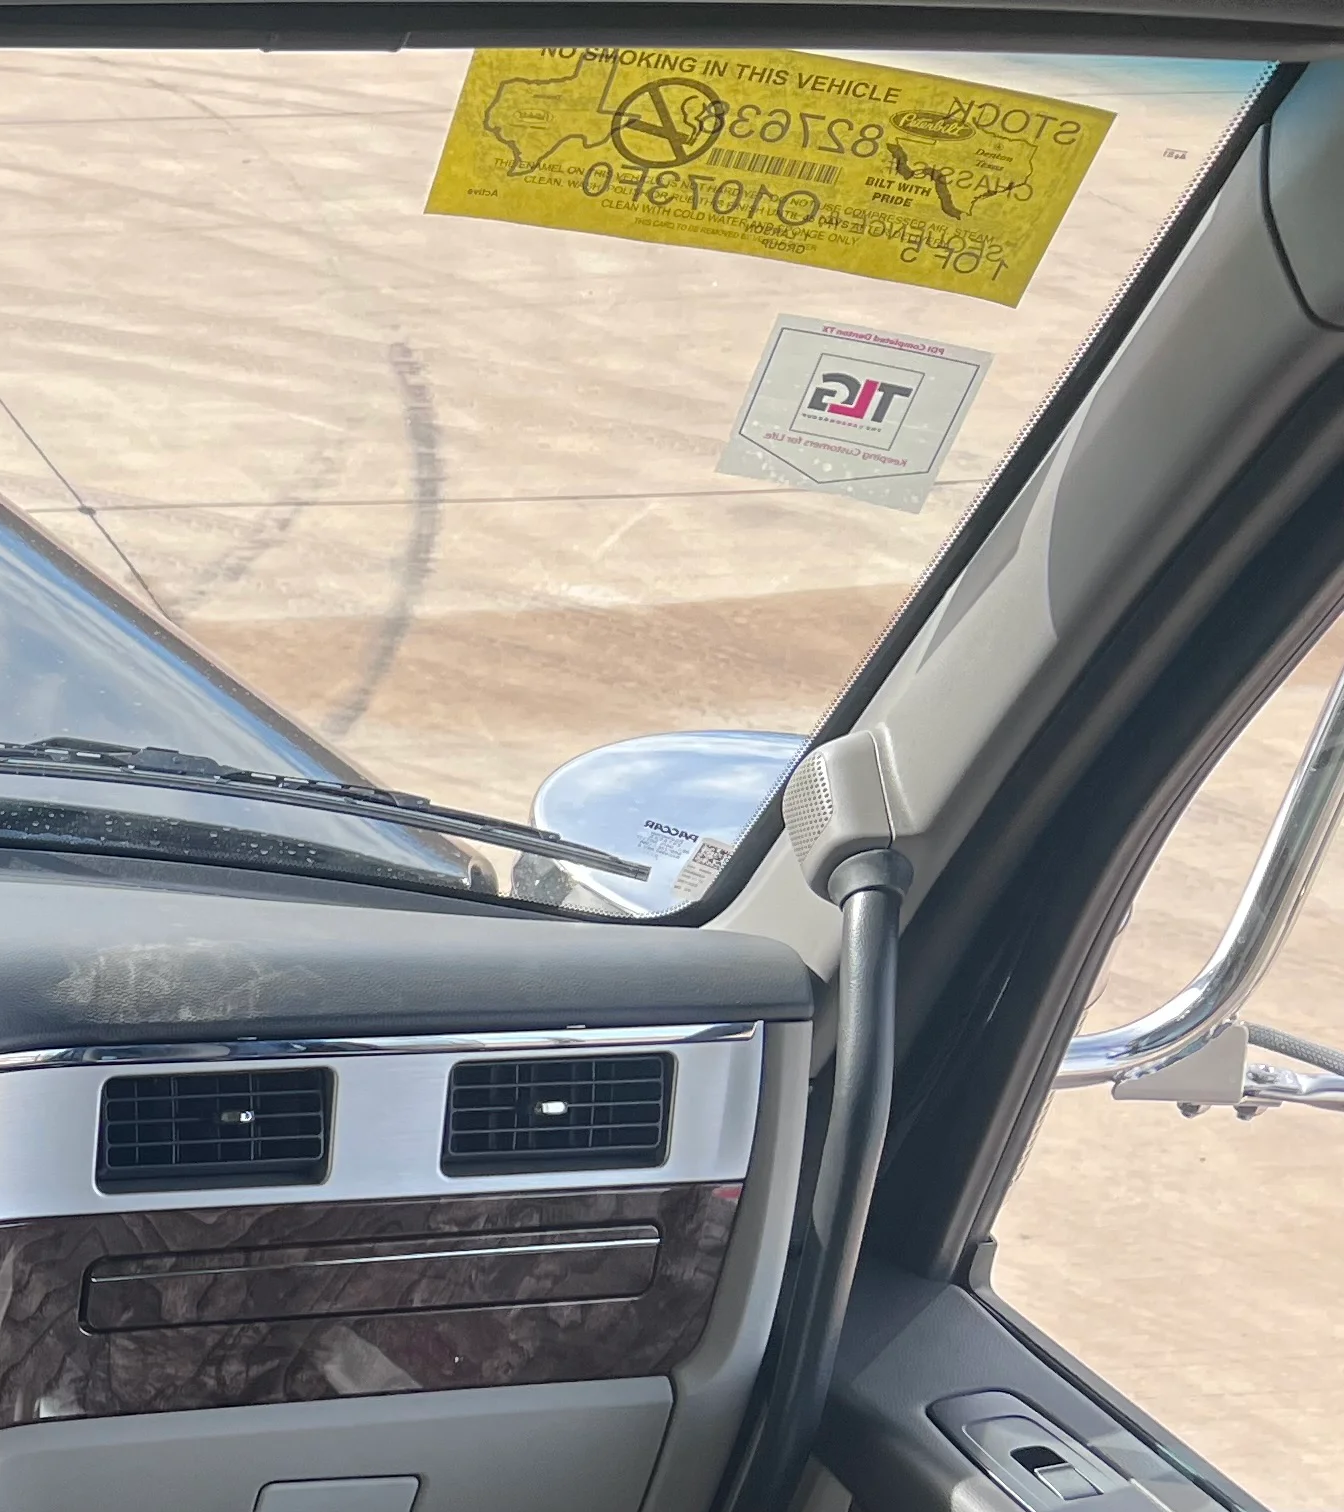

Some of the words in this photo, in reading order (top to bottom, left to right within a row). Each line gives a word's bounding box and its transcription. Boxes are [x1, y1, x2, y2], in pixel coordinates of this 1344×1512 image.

[540, 48, 576, 59] NO
[582, 48, 698, 73] SMOKING
[703, 61, 728, 77] IN
[736, 64, 789, 85] THIS
[798, 72, 902, 104] VEHICLE
[865, 176, 893, 189] BILT
[897, 182, 932, 198] WITH
[872, 192, 912, 207] PRIDE
[567, 166, 585, 175] ON
[844, 206, 926, 229] COMPRESSED
[955, 228, 994, 244] STEAM
[601, 199, 639, 211] CLEAN
[642, 205, 671, 217] WITH
[674, 209, 705, 221] COLD
[708, 214, 746, 228] WATER
